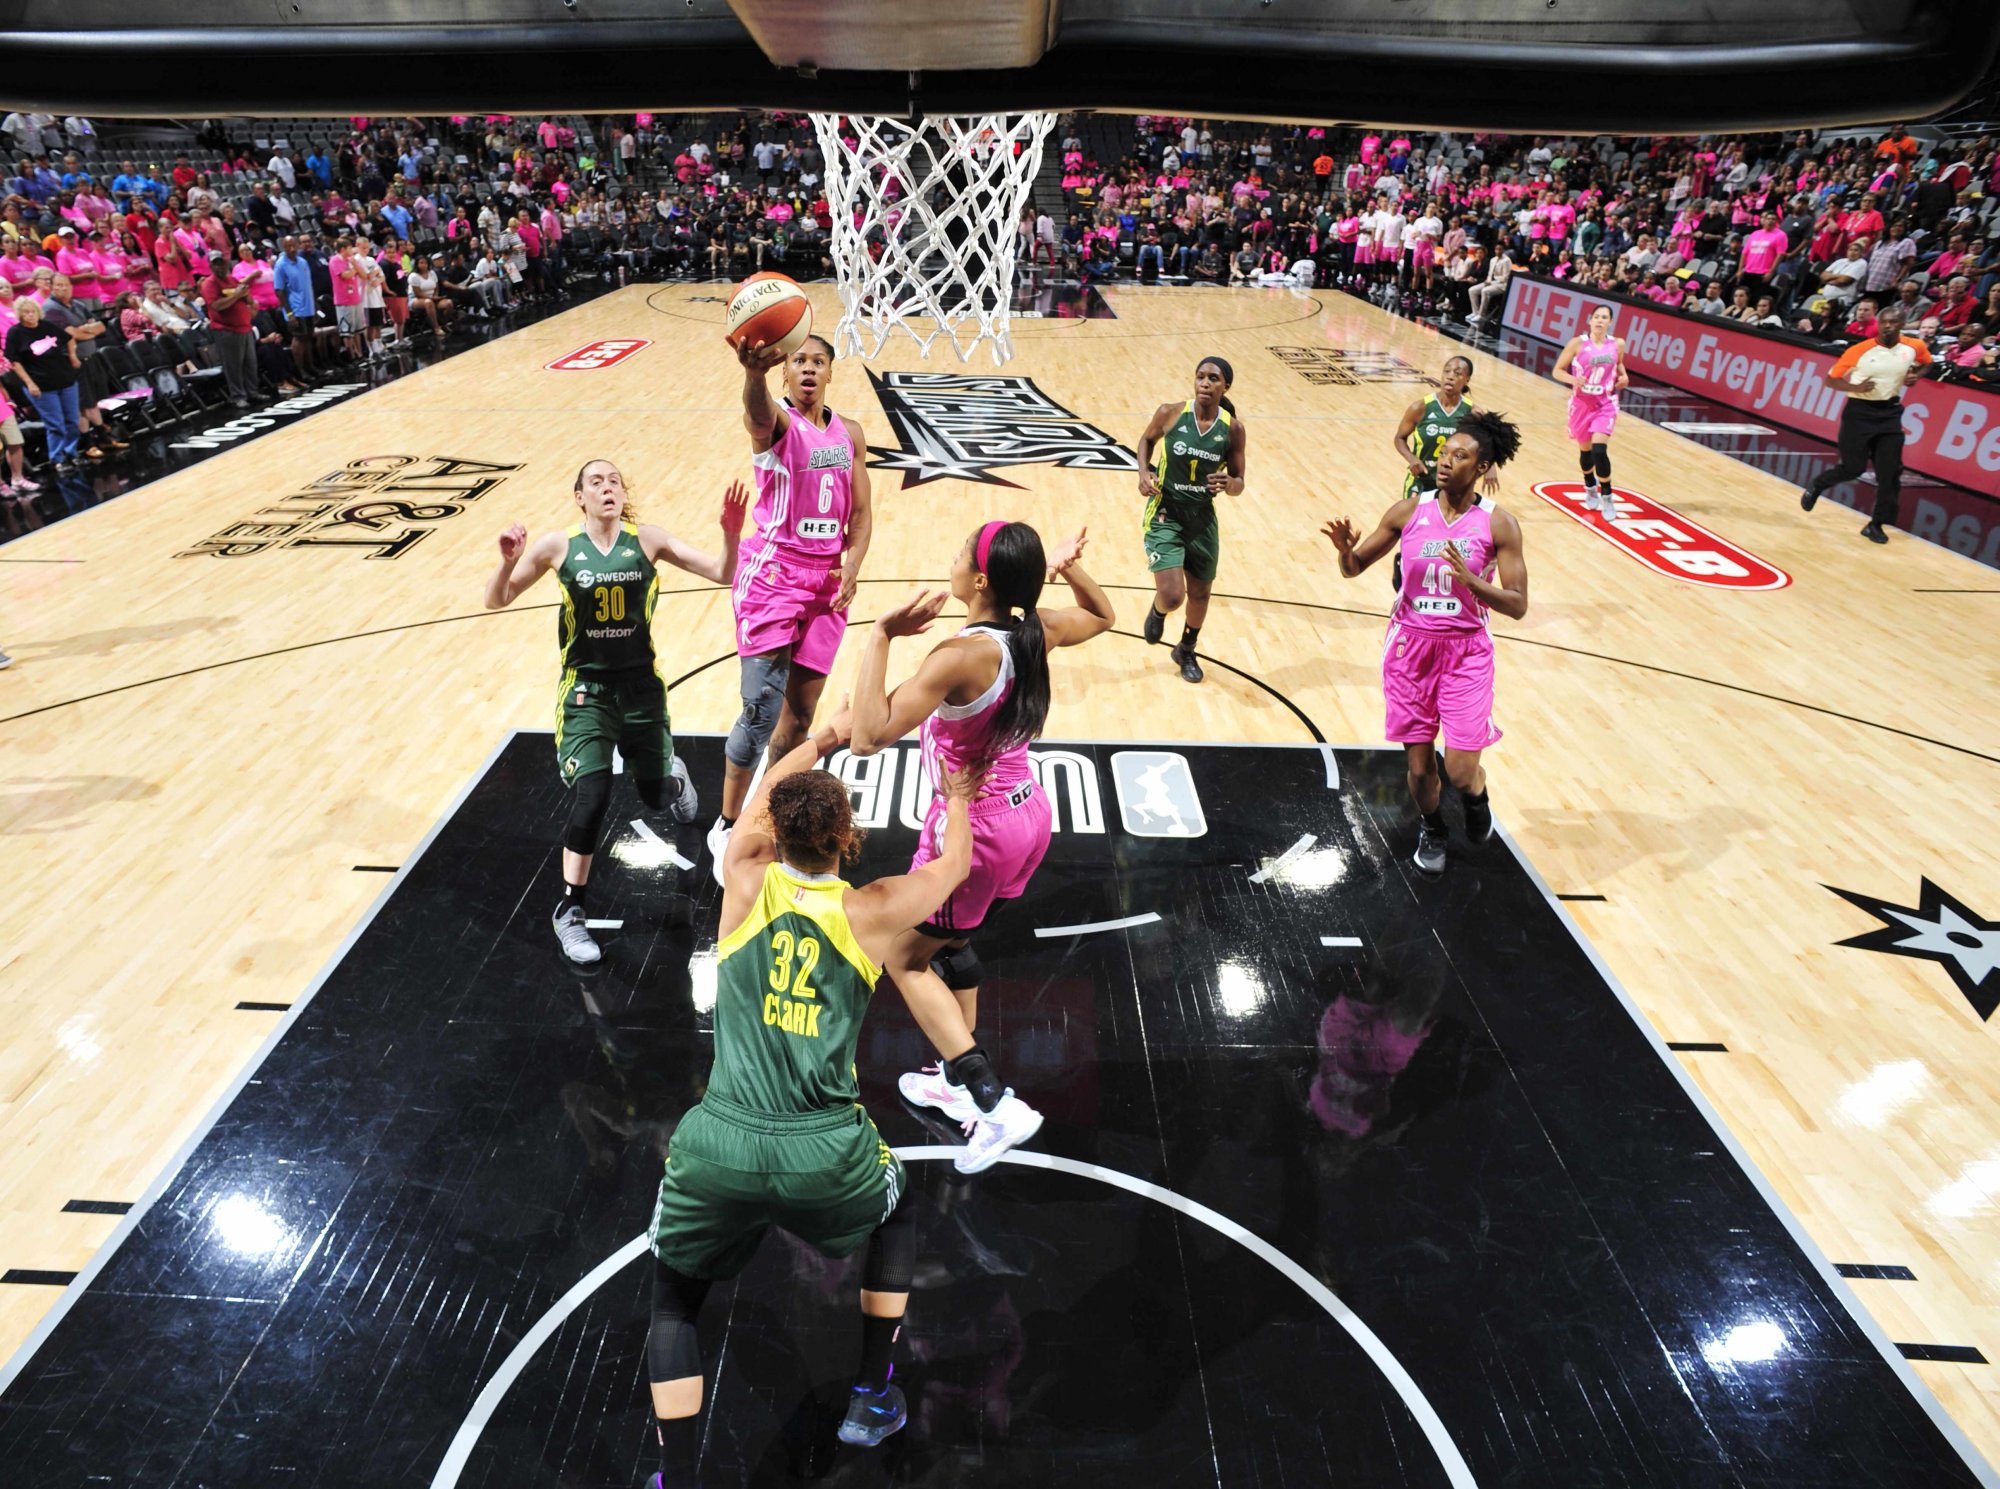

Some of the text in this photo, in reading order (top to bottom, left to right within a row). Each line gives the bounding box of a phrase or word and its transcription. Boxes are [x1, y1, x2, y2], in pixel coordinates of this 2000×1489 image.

[729, 281, 781, 322] SPALDING
[1624, 315, 1686, 370] Here
[168, 382, 369, 449] WNBA.COM
[884, 372, 1140, 471] STARS
[808, 443, 850, 470] STARS
[1187, 446, 1221, 462] SWEDISH
[1189, 459, 1199, 482] 1
[171, 455, 419, 559] CENTER
[280, 455, 528, 560] AT&T
[818, 473, 835, 514] 6
[1420, 539, 1472, 558] STS
[596, 571, 642, 583] SWEDISH
[1422, 562, 1453, 596] 40
[594, 585, 626, 622] 30
[585, 626, 633, 639] verizon
[769, 930, 820, 999] 32
